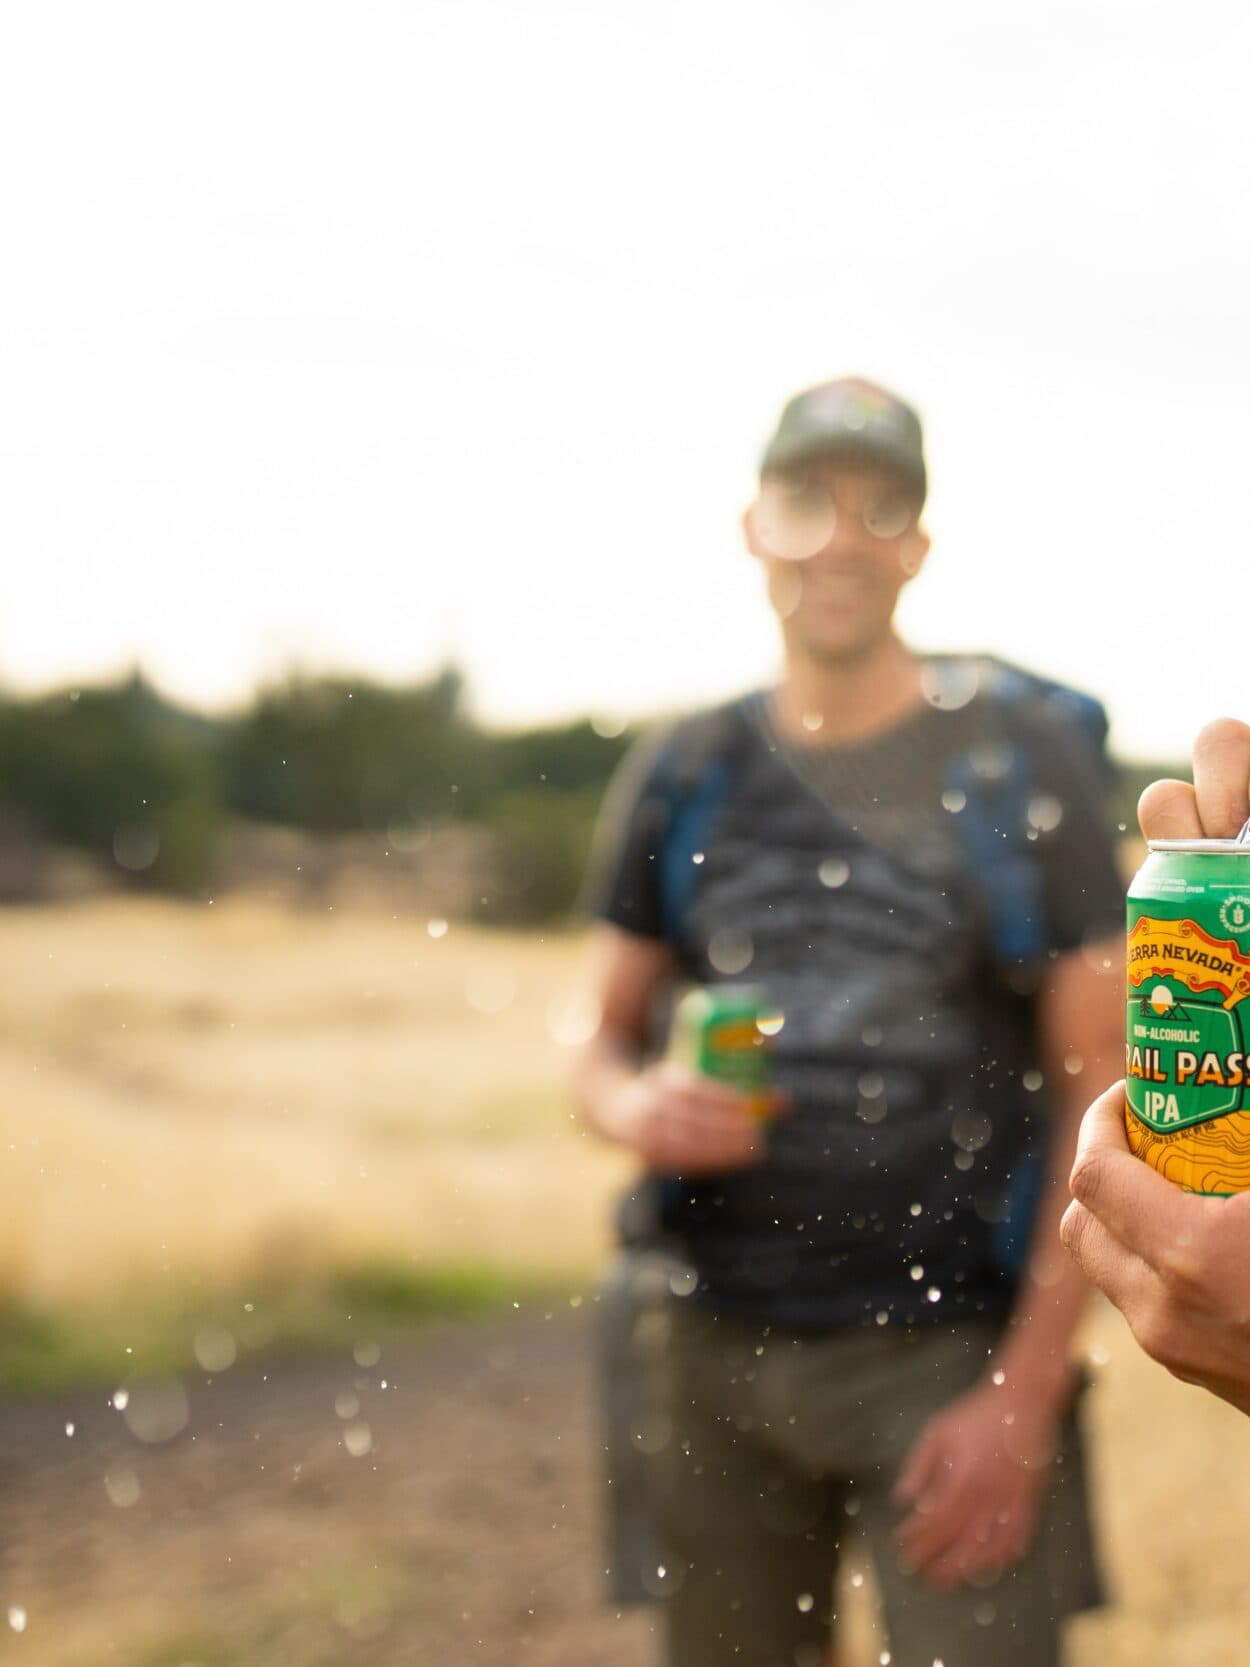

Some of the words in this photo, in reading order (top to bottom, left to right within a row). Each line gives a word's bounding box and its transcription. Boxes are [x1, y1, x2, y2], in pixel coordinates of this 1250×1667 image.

[1162, 942, 1235, 977] NEVADA
[1134, 1024, 1200, 1043] NON-ALCOHOLIC
[1126, 1043, 1168, 1084] RAIL
[1144, 1090, 1181, 1124] IPA
